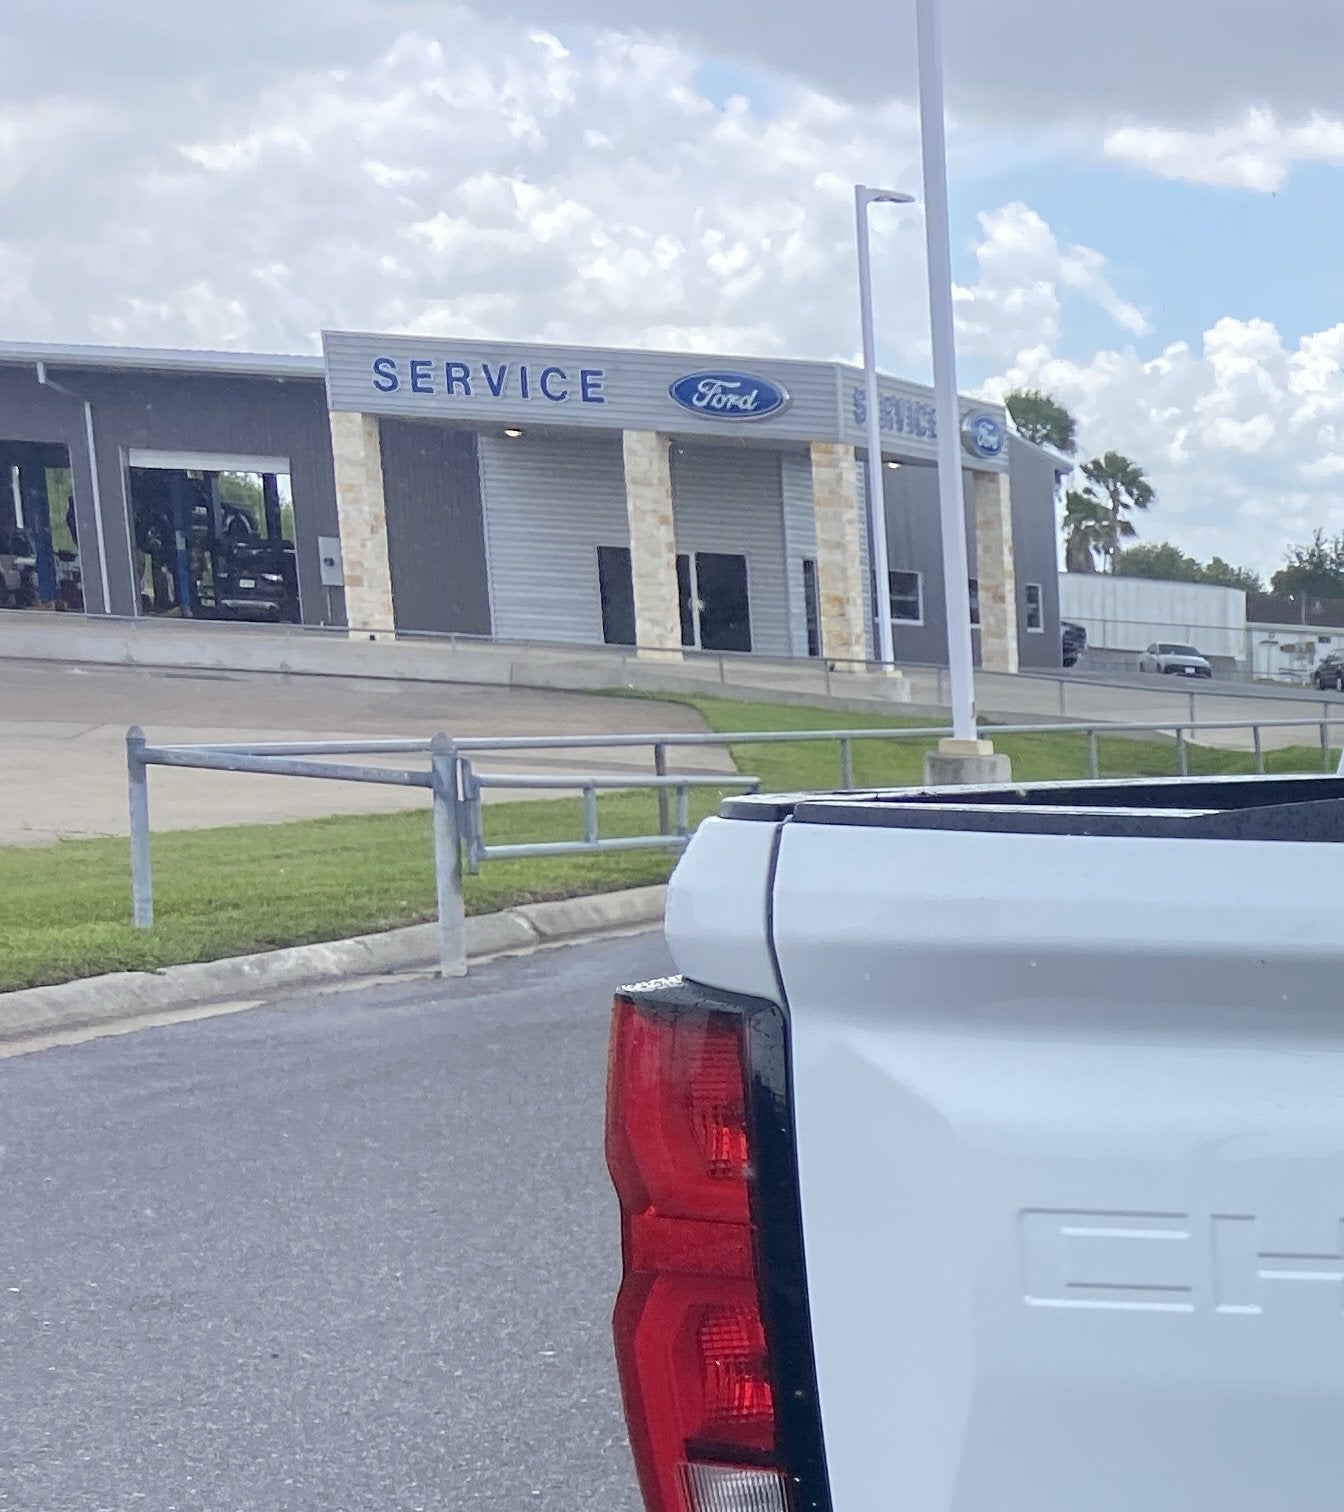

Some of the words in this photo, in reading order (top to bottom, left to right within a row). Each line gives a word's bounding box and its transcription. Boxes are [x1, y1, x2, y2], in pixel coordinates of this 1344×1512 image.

[372, 357, 606, 404] SERVICE
[691, 378, 761, 412] Ford
[854, 386, 938, 439] SRVICE
